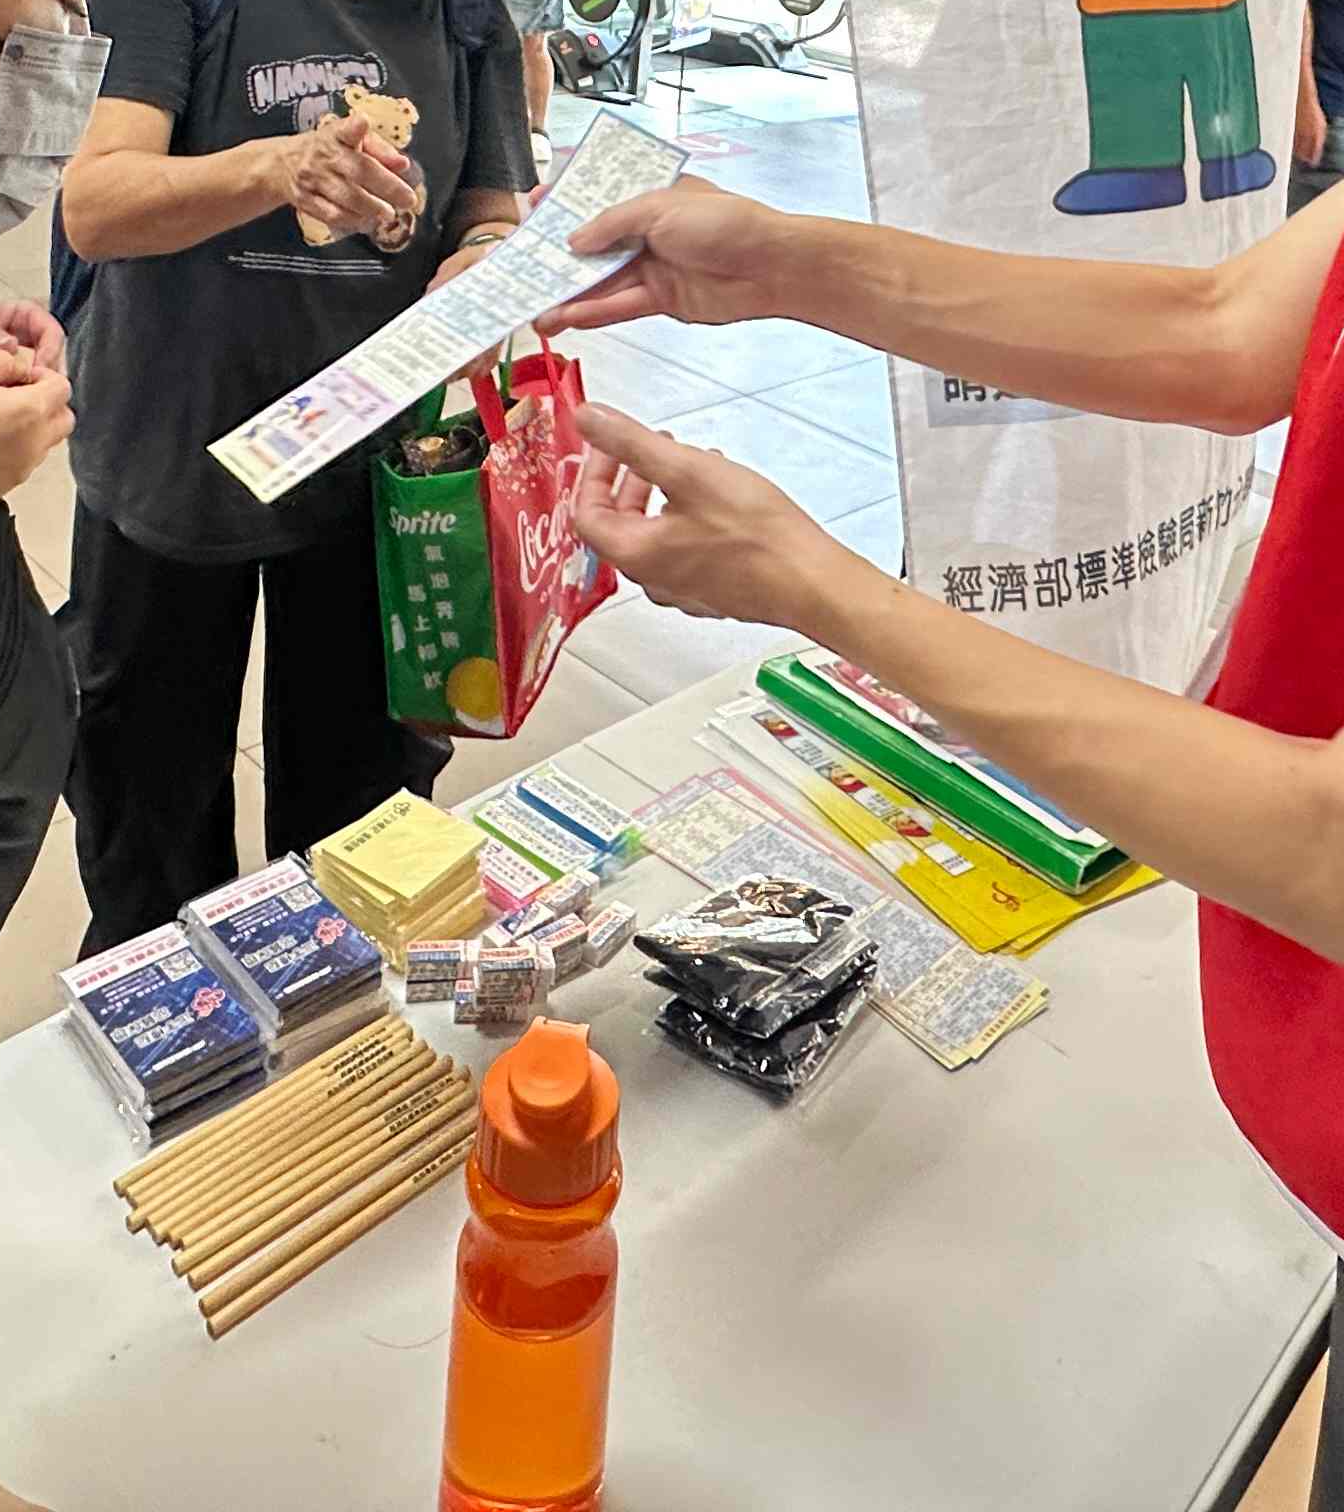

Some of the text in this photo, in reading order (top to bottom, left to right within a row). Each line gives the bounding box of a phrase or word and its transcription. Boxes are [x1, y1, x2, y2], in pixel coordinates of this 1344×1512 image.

[388, 506, 457, 536] Sprite
[942, 456, 1256, 613] 經濟部標準檢驗局新竹
